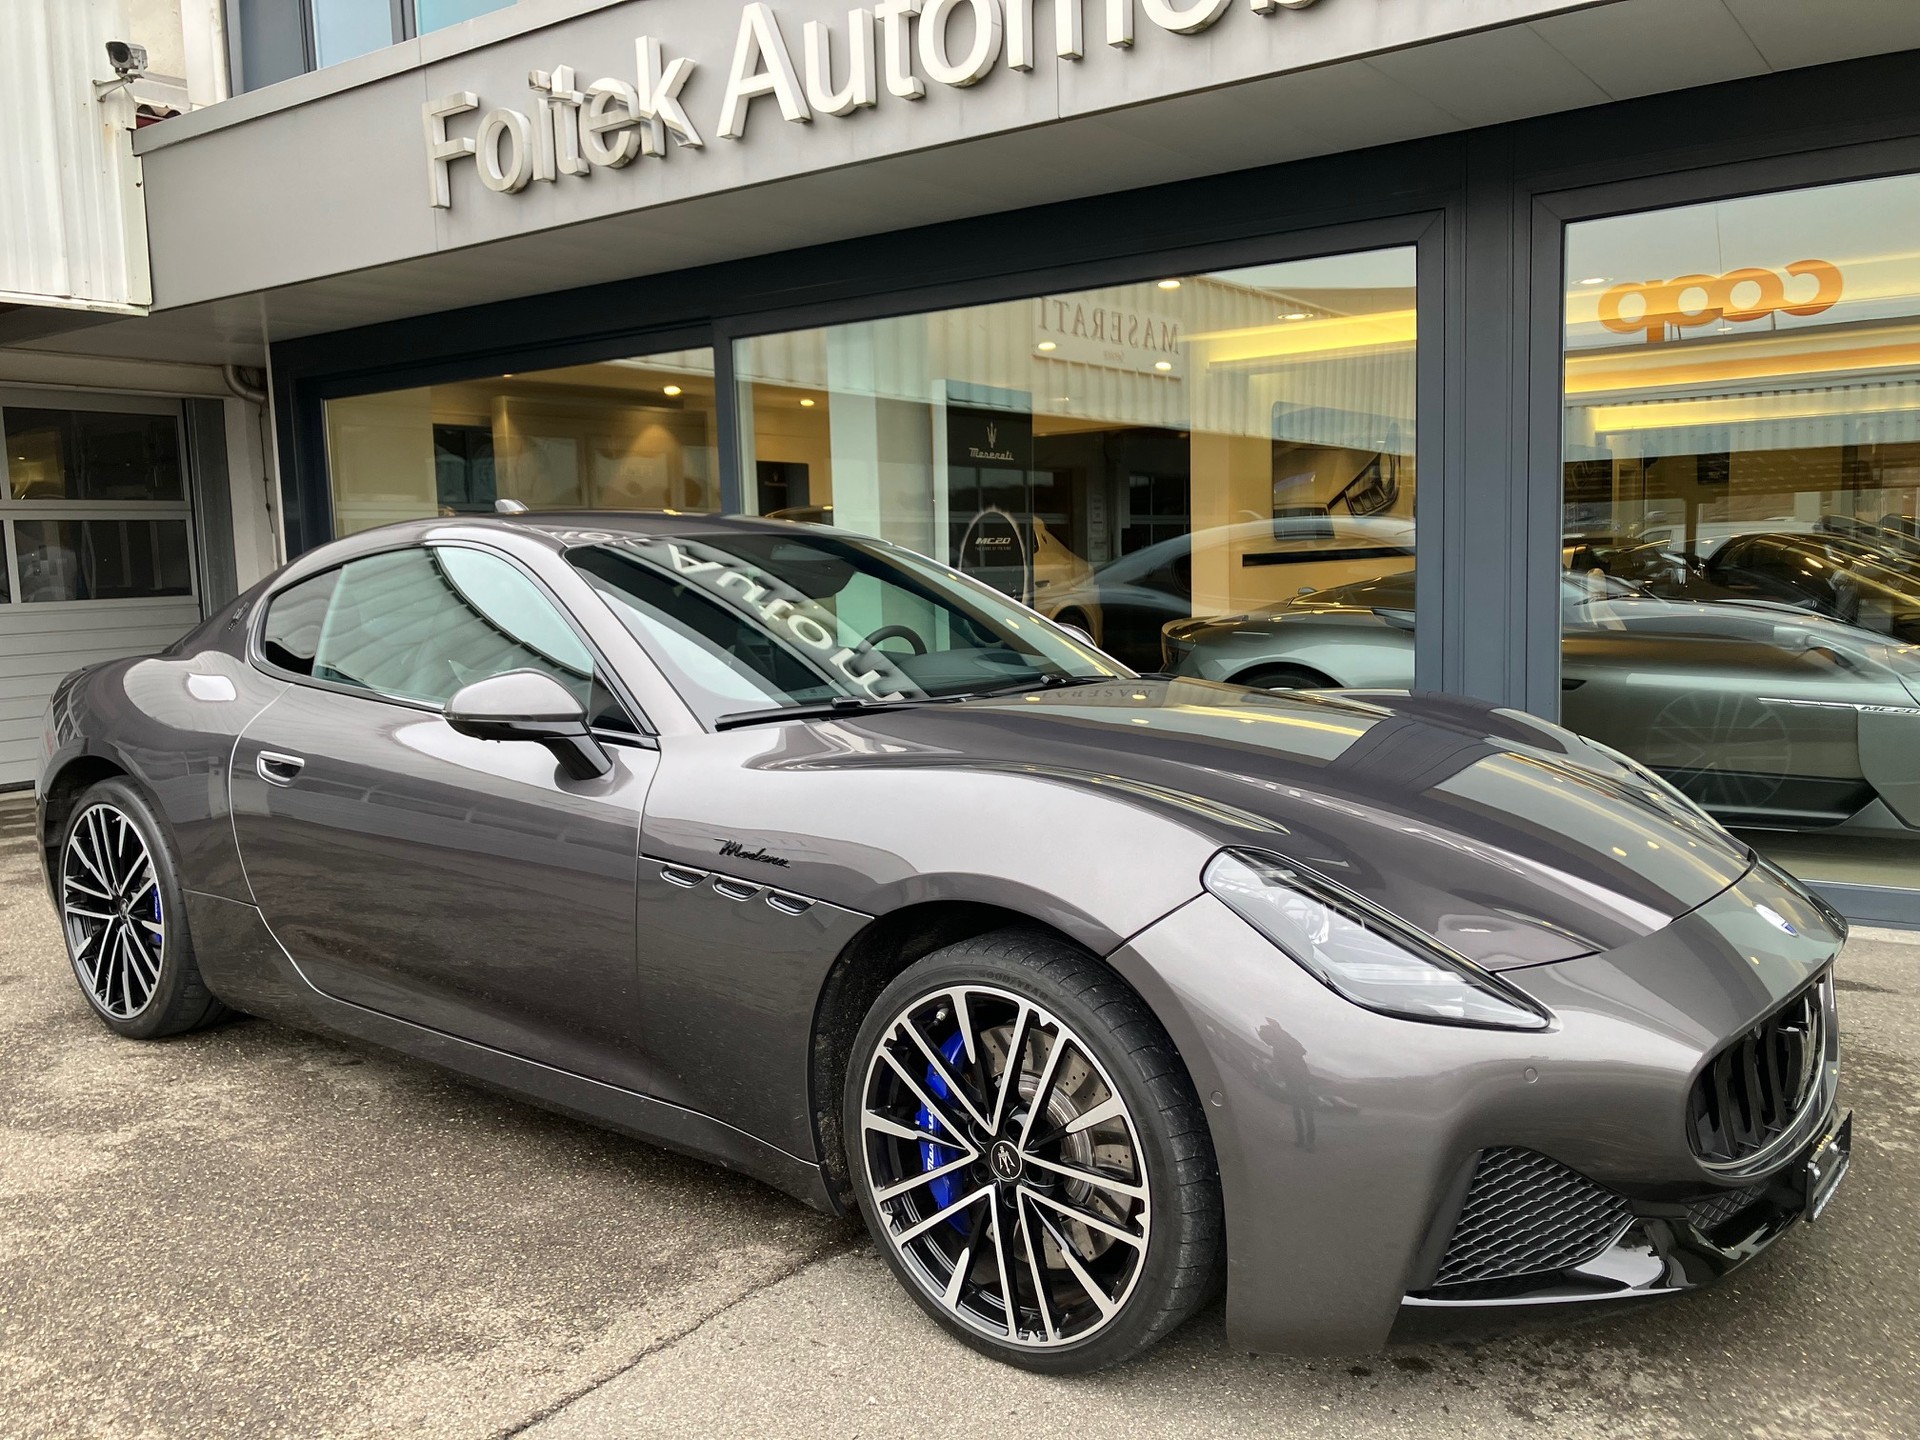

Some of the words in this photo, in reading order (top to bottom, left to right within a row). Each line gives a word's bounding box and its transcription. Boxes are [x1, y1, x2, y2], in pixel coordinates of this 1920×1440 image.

[424, 34, 704, 210] Foitek
[969, 447, 1014, 461] Maserati
[975, 537, 1011, 545] MC20
[713, 838, 791, 869] Modena
